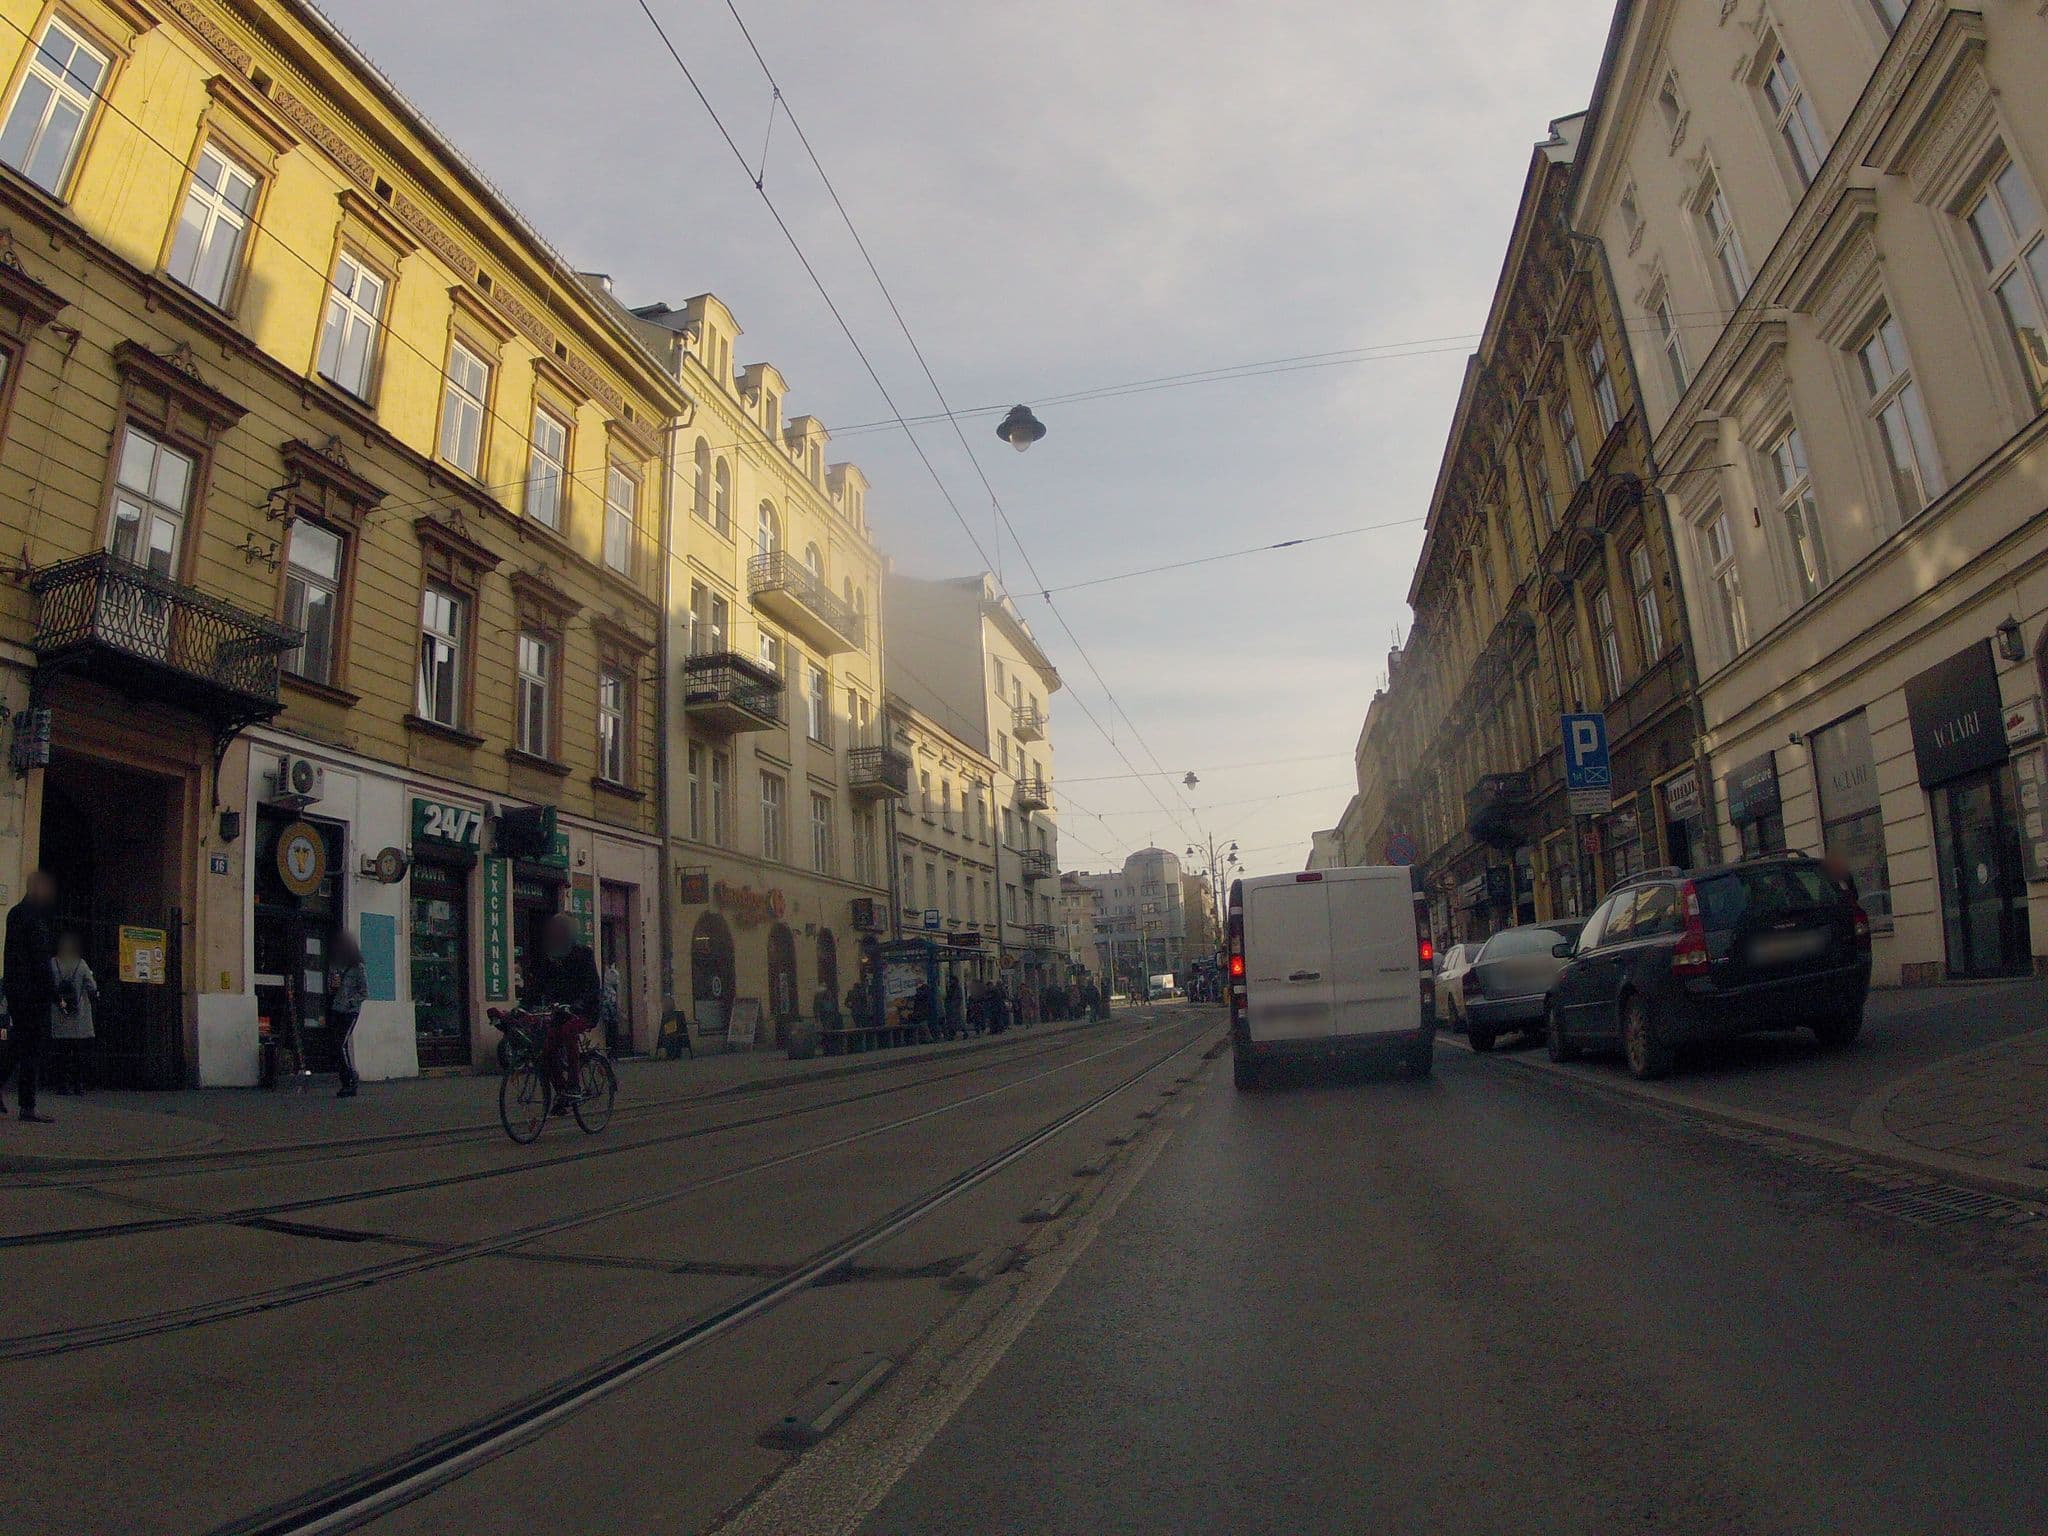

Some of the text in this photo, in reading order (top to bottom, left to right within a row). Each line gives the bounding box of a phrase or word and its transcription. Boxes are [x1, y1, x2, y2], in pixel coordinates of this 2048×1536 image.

[1571, 720, 1599, 766] P
[424, 804, 483, 845] 24/7
[490, 864, 500, 993] EXCHANGE
